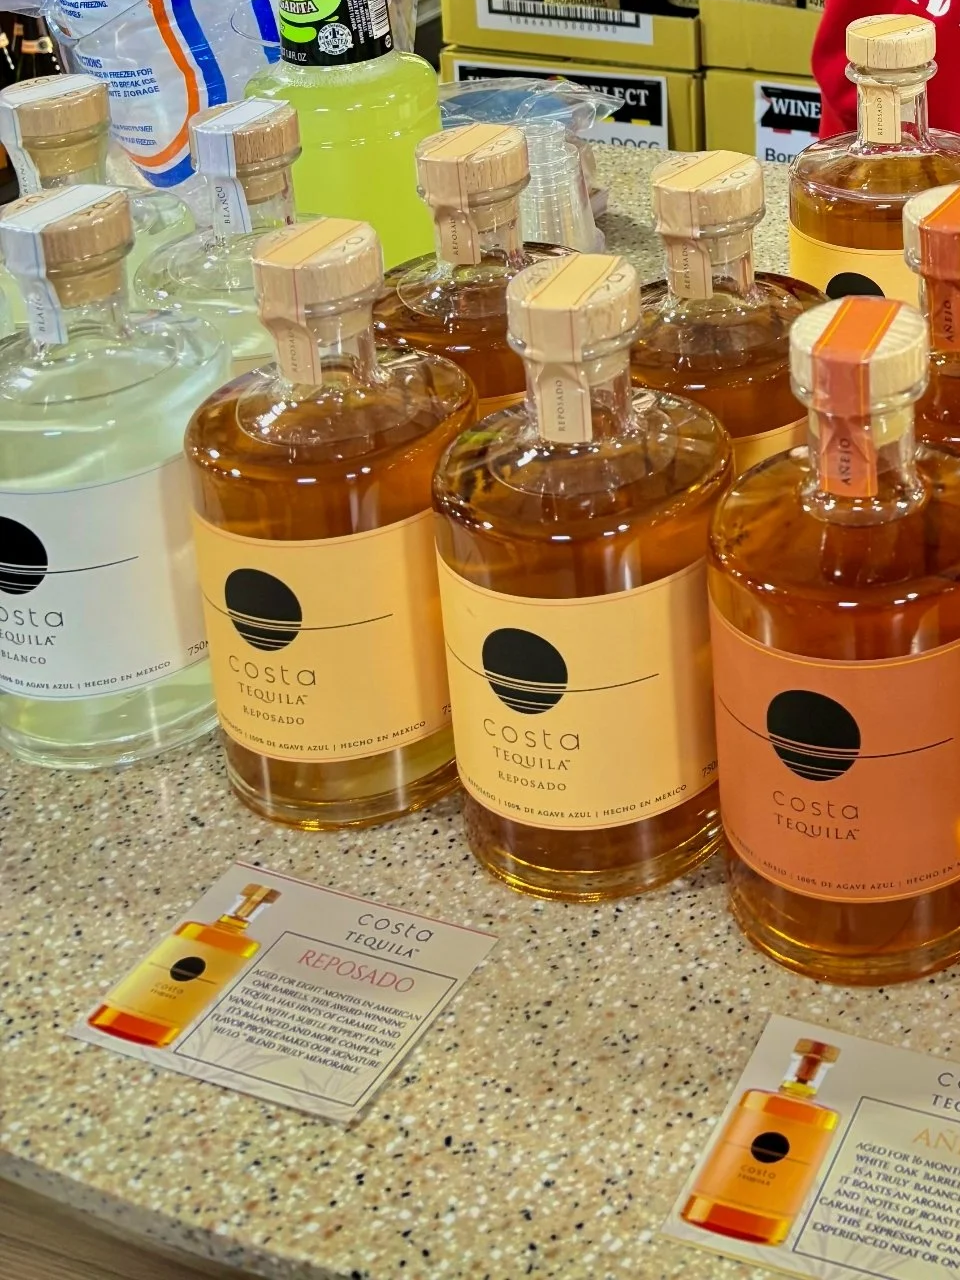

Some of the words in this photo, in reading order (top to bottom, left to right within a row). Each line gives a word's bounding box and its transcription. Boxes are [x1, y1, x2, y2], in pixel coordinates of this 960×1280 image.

[109, 71, 136, 79] FREEZER
[137, 68, 153, 76] FOR
[142, 77, 157, 85] ICE
[123, 86, 160, 97] STORAGE
[771, 97, 821, 118] WINE
[876, 97, 884, 136] REPOSADO
[216, 186, 232, 224] BLANCO
[681, 242, 691, 290] REPOSADO
[943, 299, 957, 344] AÑEJO
[288, 327, 298, 373] REPOSADO
[557, 380, 566, 432] REPOSADO
[840, 437, 853, 488] AÑEJO
[1, 650, 47, 666] BLANCO
[229, 655, 316, 686] costa
[26, 681, 50, 690] AGAVE
[84, 678, 117, 689] HECHO
[121, 674, 133, 683] EN
[136, 661, 171, 677] MEXICO
[238, 682, 306, 706] TEQUILA
[243, 705, 305, 726] REPOSADO
[483, 718, 580, 751] costa
[493, 746, 569, 771] TEQUILA
[498, 770, 567, 792] REPOSADO
[504, 801, 521, 812] 100%
[524, 806, 535, 815] DE
[538, 810, 565, 818] AGAVE
[603, 803, 636, 816] HECHO
[640, 799, 652, 808] EN
[655, 784, 687, 803] MEXICO
[773, 790, 859, 820] costa
[774, 812, 860, 841] TEQUILA
[358, 914, 434, 942] costa
[344, 930, 417, 959] TEQUILA
[297, 949, 414, 993] REPOSADO
[253, 969, 278, 980] AGED
[278, 976, 296, 985] FOR
[296, 981, 323, 993] EIGHT
[323, 989, 363, 1004] MONTHS
[362, 1000, 374, 1008] IN
[374, 1003, 422, 1021] AMERICAN
[855, 1141, 887, 1156] AGED
[887, 1150, 910, 1162] FOR
